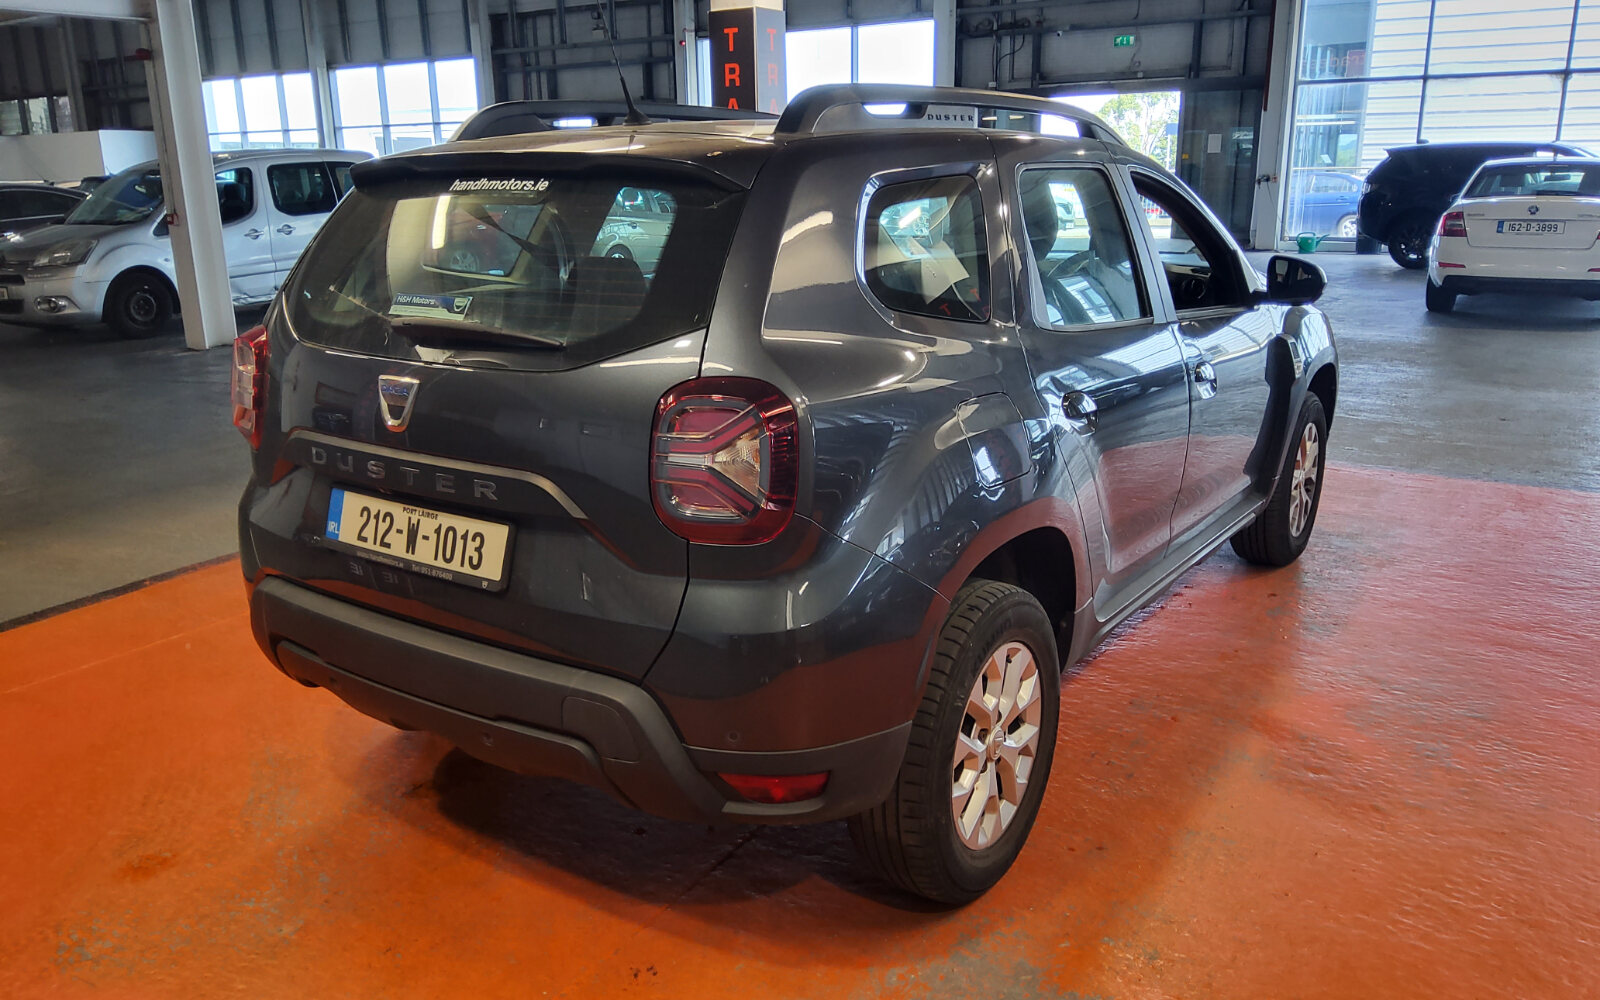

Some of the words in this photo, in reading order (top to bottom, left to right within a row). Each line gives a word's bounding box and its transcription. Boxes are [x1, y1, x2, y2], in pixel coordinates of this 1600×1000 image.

[927, 113, 974, 122] DUSTER
[449, 178, 549, 191] handhmotors.ie
[1508, 223, 1558, 232] 162-D-3899
[411, 297, 436, 305] Motors
[311, 447, 499, 501] DUSTER
[403, 507, 417, 516] PORT
[327, 520, 340, 534] IRL
[356, 505, 485, 571] 212-W-1013
